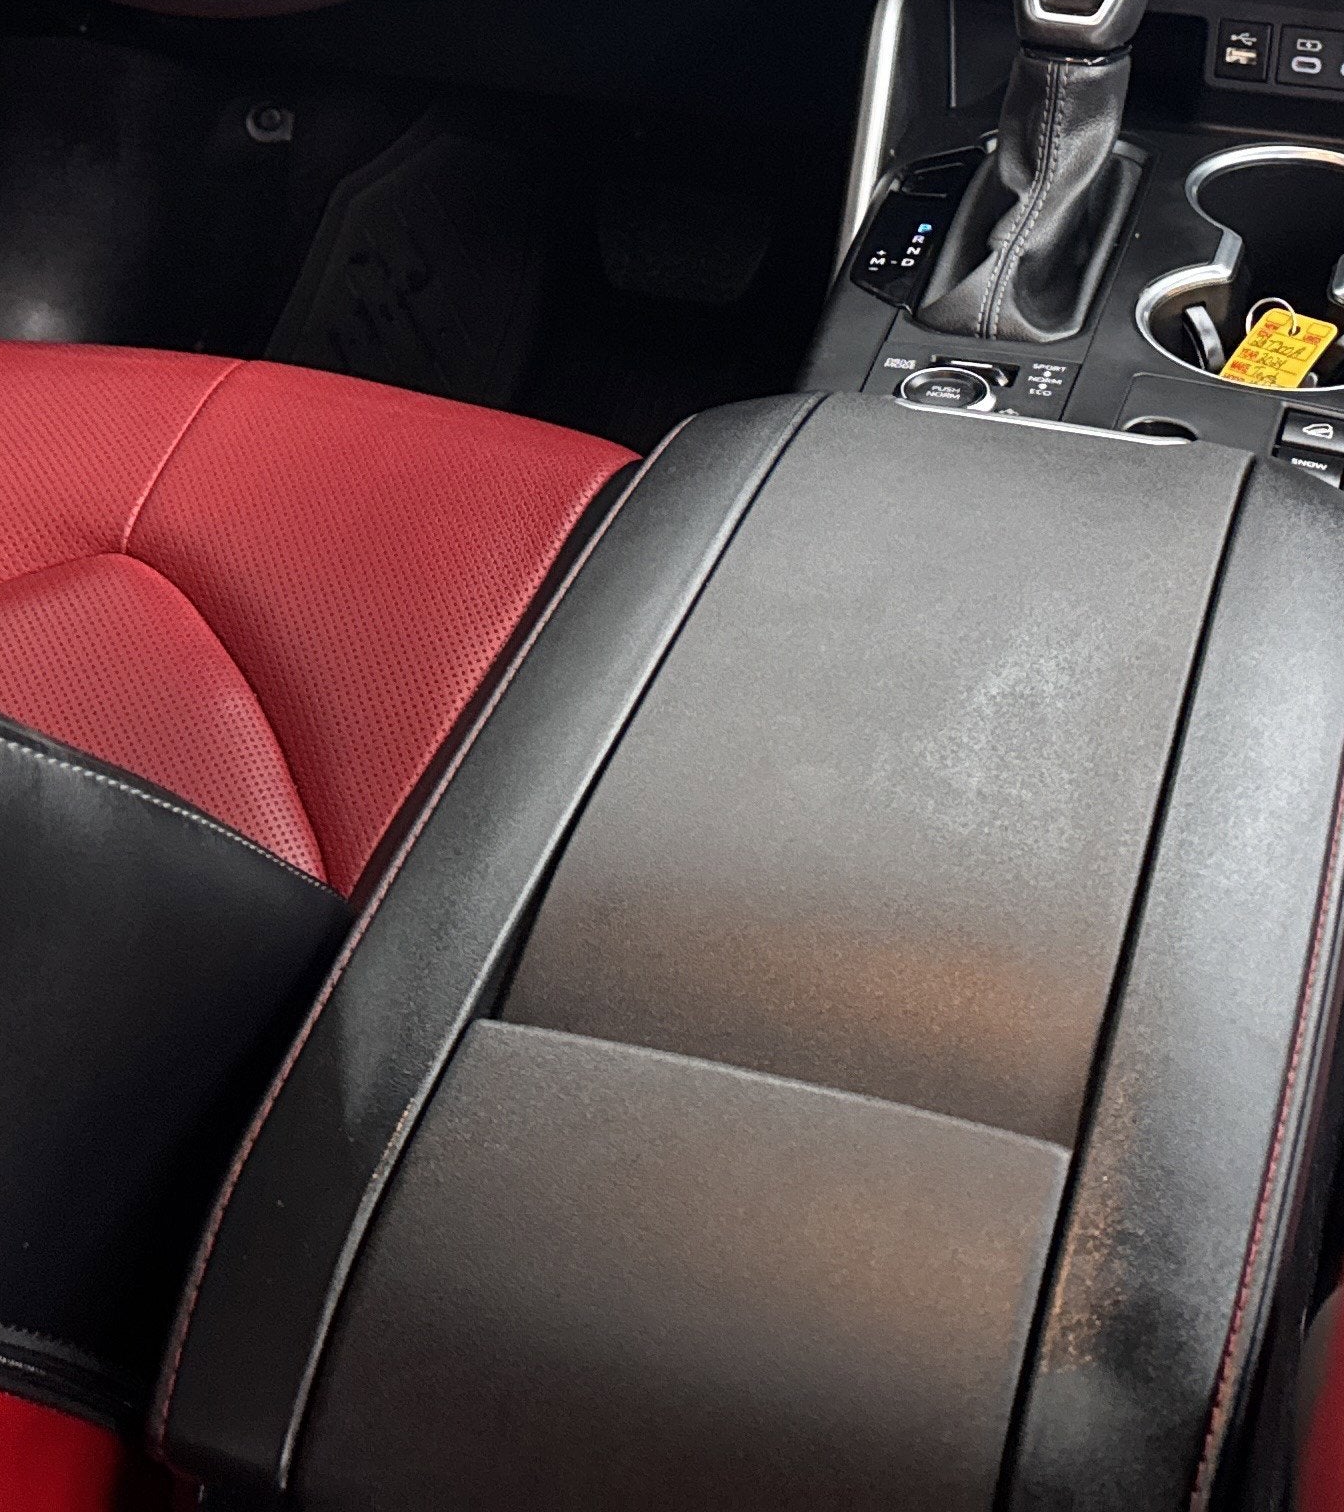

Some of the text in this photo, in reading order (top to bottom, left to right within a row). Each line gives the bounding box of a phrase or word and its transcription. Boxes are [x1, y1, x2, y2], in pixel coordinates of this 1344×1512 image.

[911, 235, 926, 244] R
[906, 246, 921, 255] N
[869, 257, 915, 267] M D
[1032, 363, 1067, 372] SPORT
[1028, 376, 1063, 385] NORM
[931, 385, 961, 393] PUSH
[1029, 388, 1052, 397] ECO
[925, 390, 961, 400] NORM
[1291, 457, 1328, 470] SNOW
